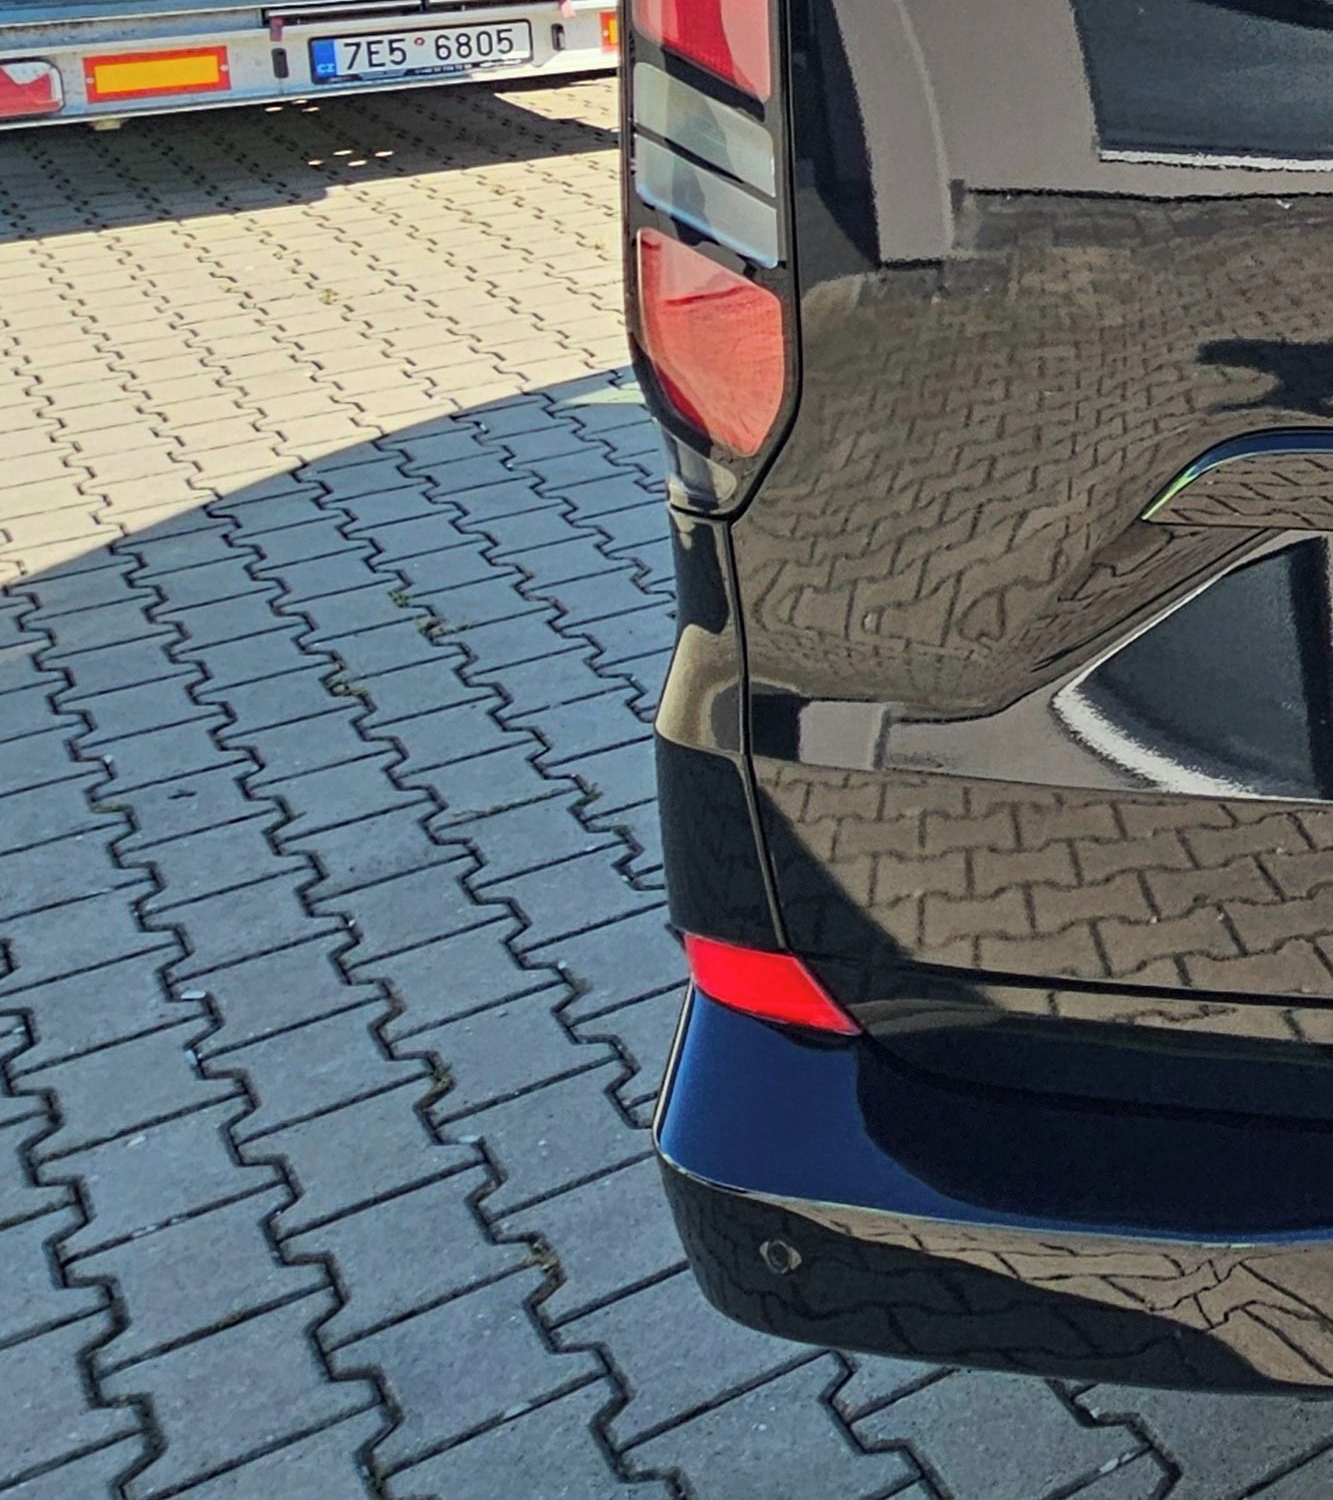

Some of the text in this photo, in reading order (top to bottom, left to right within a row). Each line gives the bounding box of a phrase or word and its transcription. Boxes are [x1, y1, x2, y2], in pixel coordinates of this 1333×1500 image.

[343, 28, 514, 70] 7E5 6805
[316, 63, 336, 74] CZ
